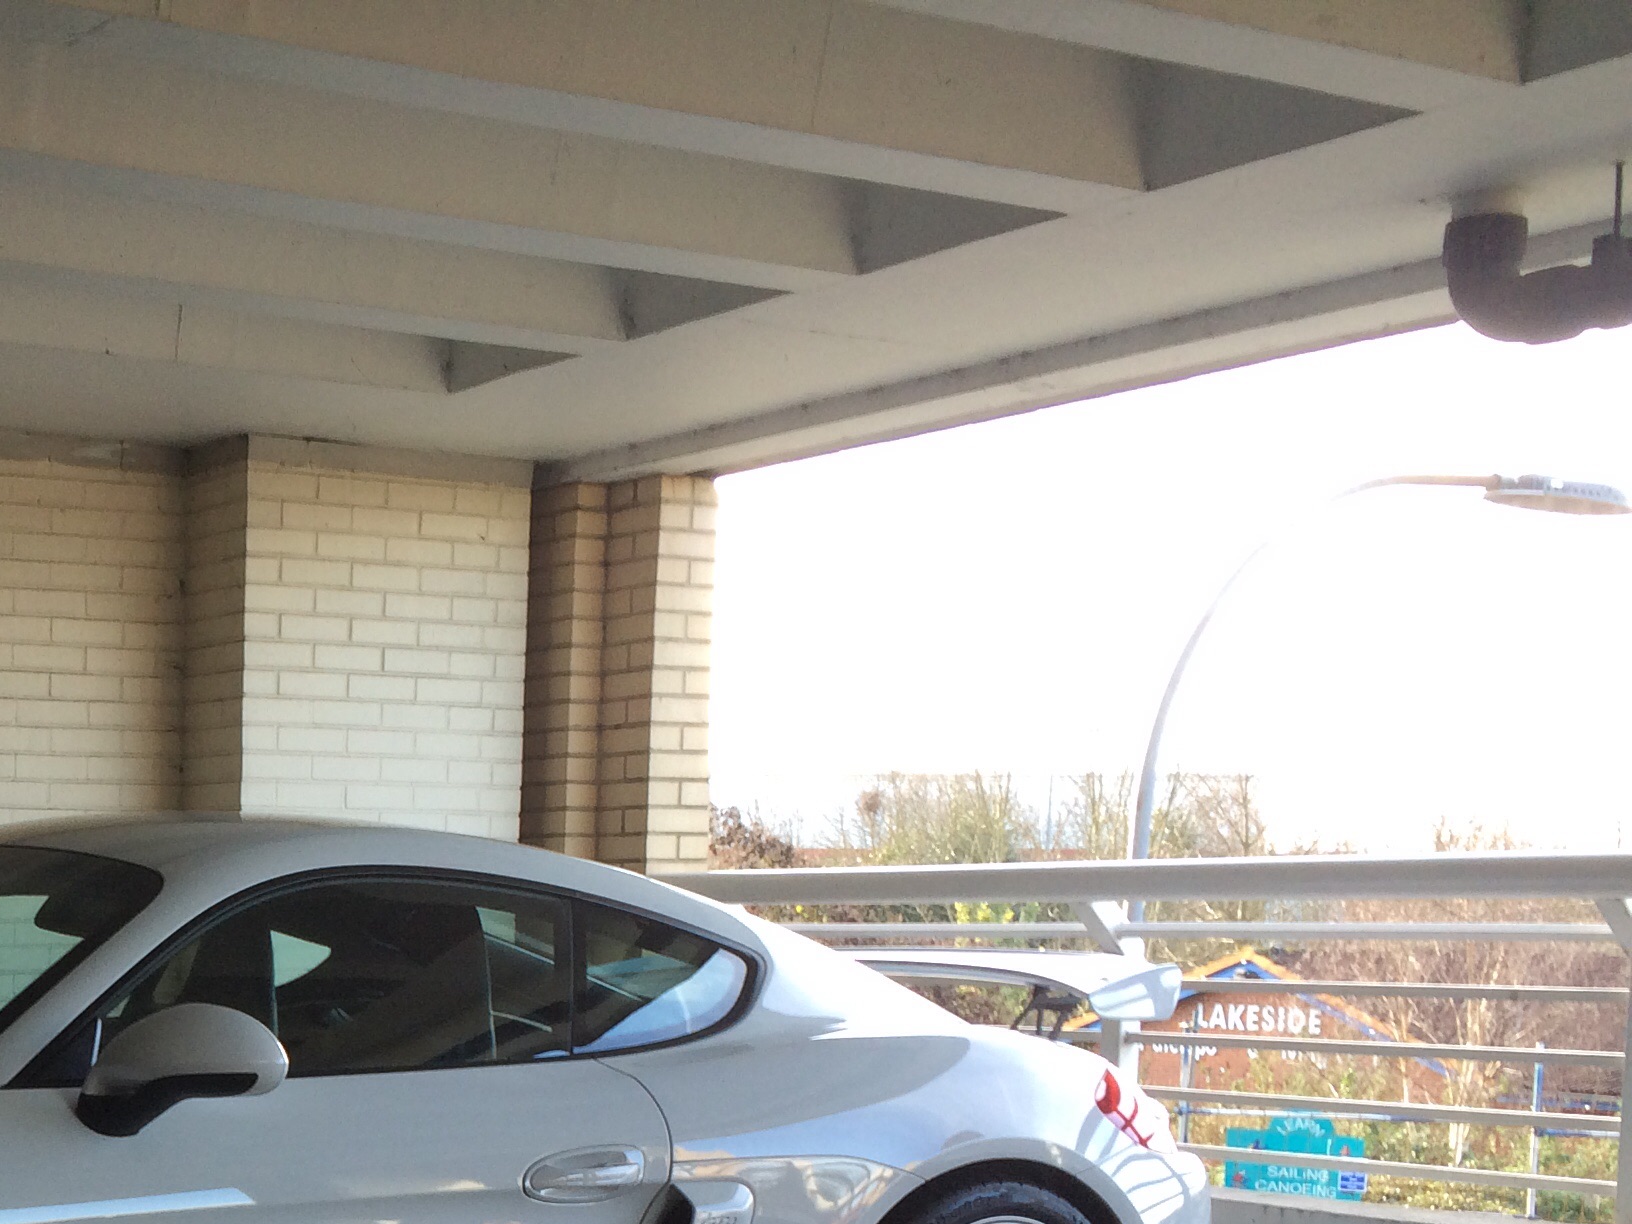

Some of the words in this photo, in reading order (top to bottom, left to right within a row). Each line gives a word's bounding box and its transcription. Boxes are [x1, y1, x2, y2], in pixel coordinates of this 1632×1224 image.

[1197, 1003, 1322, 1035] LAKESIDE
[1267, 1165, 1329, 1182] SAILING
[1254, 1179, 1337, 1199] CANOEING
